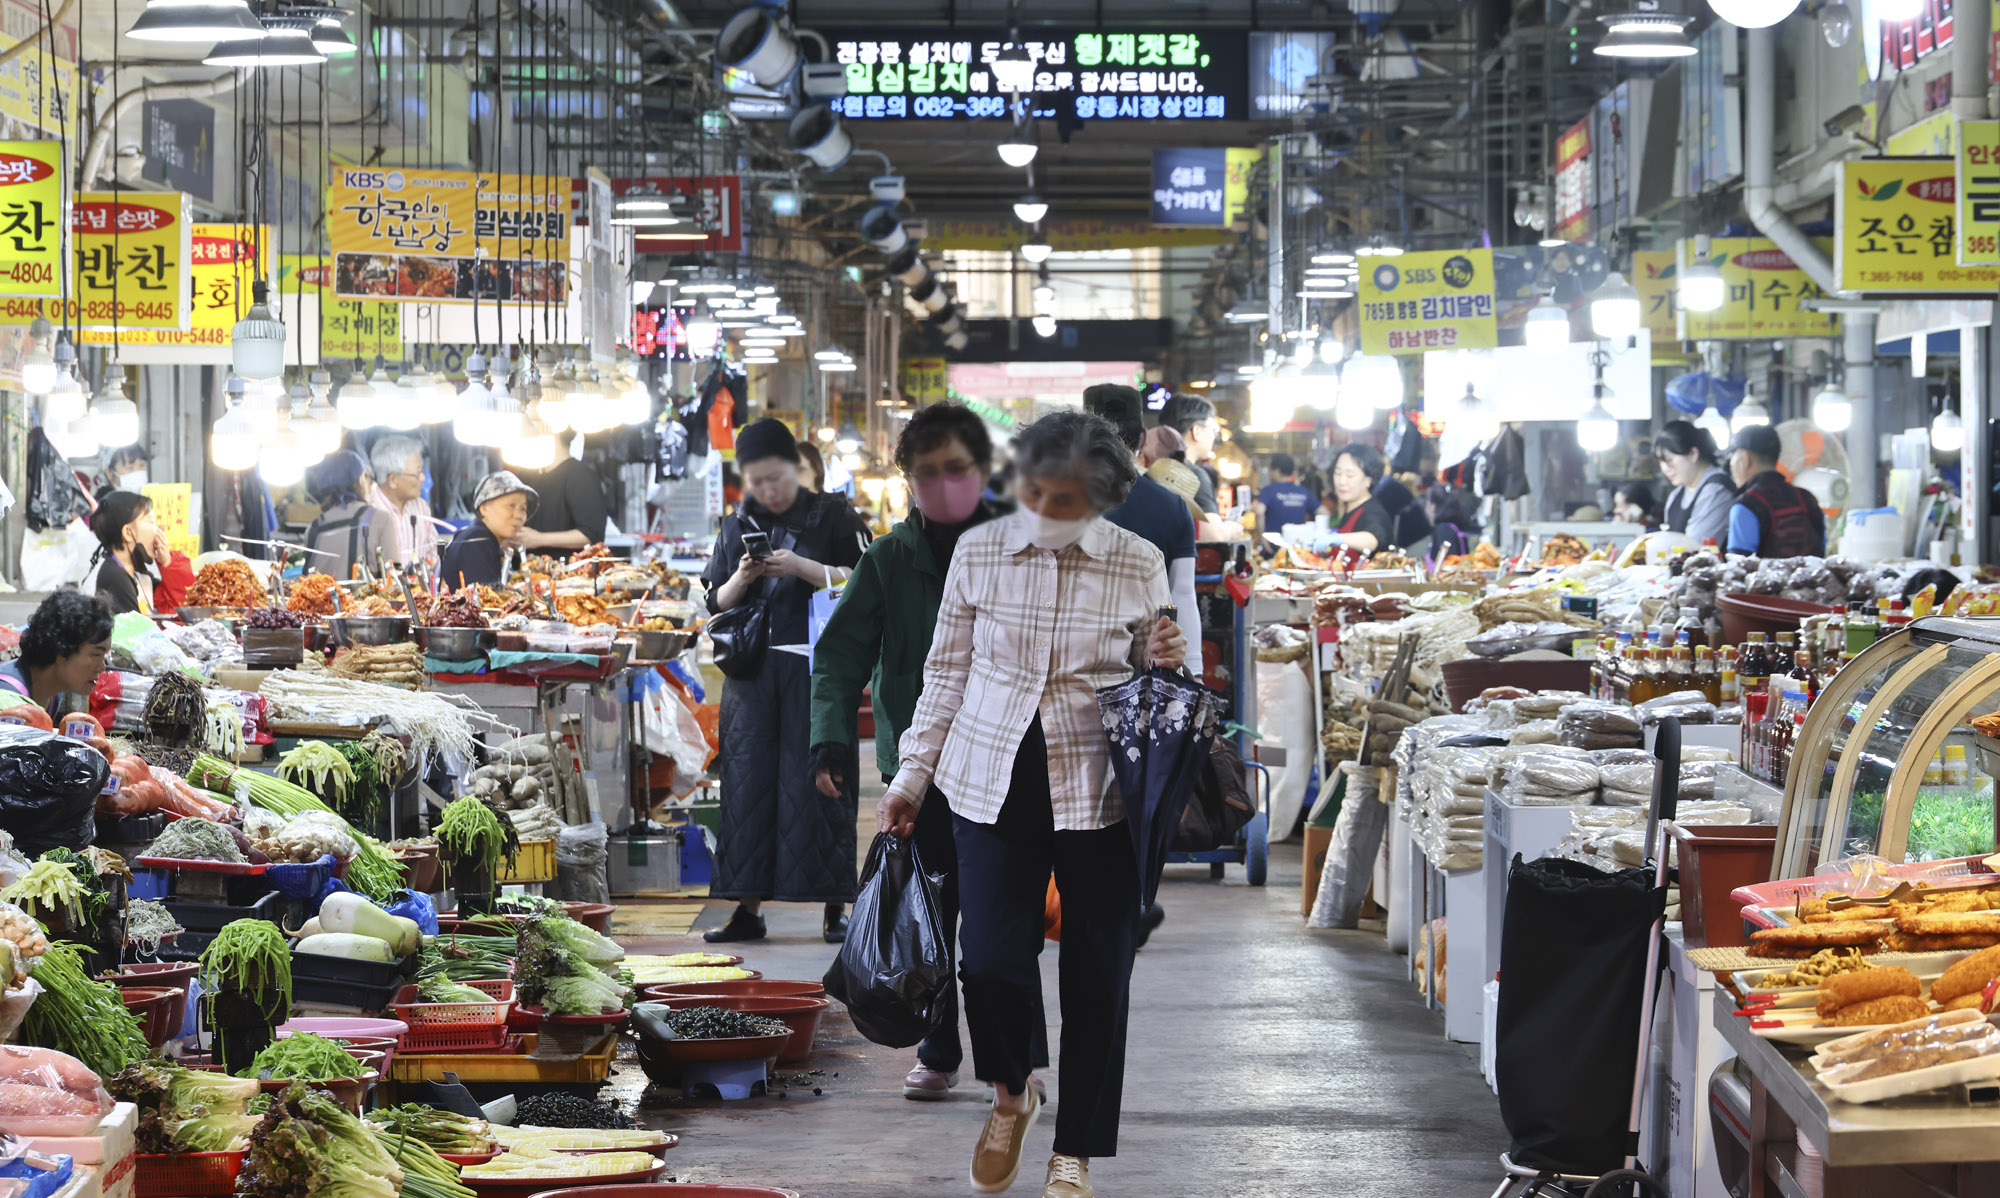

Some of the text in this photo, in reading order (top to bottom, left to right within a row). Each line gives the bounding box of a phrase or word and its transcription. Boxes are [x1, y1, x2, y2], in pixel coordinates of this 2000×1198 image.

[837, 34, 1210, 67] 전광판 설치에 도주신 형제젓갈,
[845, 62, 988, 93] 일심김치에
[1080, 72, 1204, 92] 감사드립니다.
[1076, 96, 1225, 118] 양동시장상인회
[345, 171, 385, 188] KBS
[0, 200, 55, 252] 찬
[114, 209, 160, 230] 손맛
[341, 192, 447, 238] 한국인의
[473, 208, 564, 240] 일심상회
[387, 221, 465, 253] 밥상
[1856, 213, 1955, 258] 조은참
[1967, 235, 1996, 254] 365
[75, 244, 176, 290] 반찬
[1405, 267, 1437, 284] SBS
[1421, 294, 1493, 320] 김치달인
[1388, 327, 1458, 349] 하남반찬
